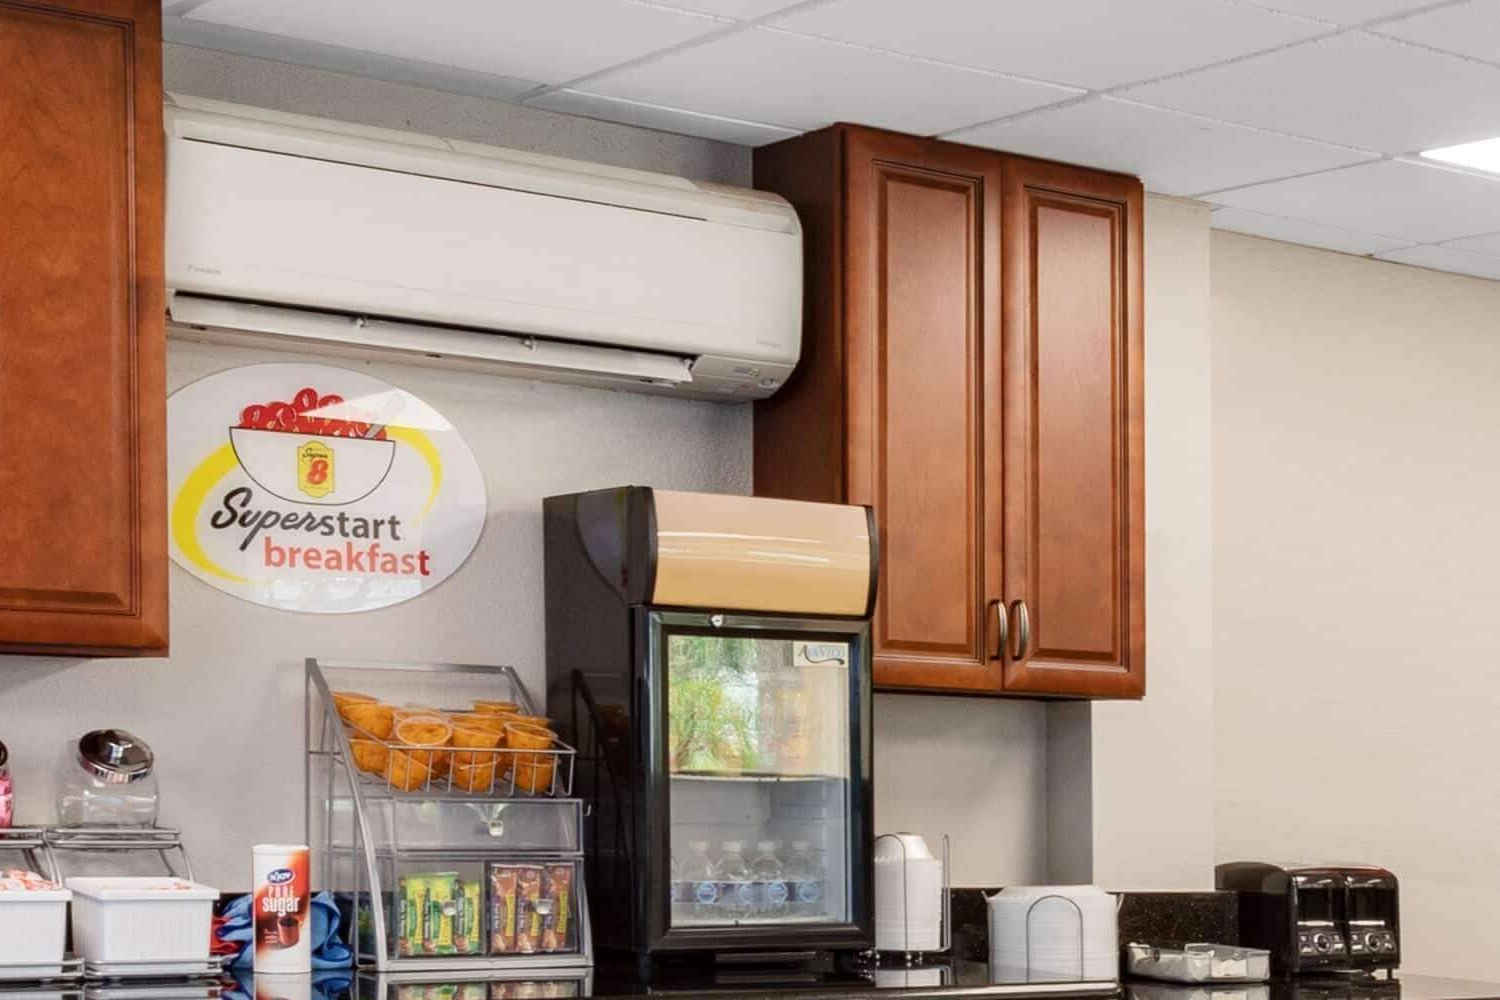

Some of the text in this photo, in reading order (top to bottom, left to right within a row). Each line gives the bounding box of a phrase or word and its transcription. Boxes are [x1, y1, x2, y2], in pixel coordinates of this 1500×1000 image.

[308, 460, 328, 485] 8
[211, 486, 401, 552] Superstart
[263, 536, 430, 576] breakfast
[262, 897, 300, 917] sugar
